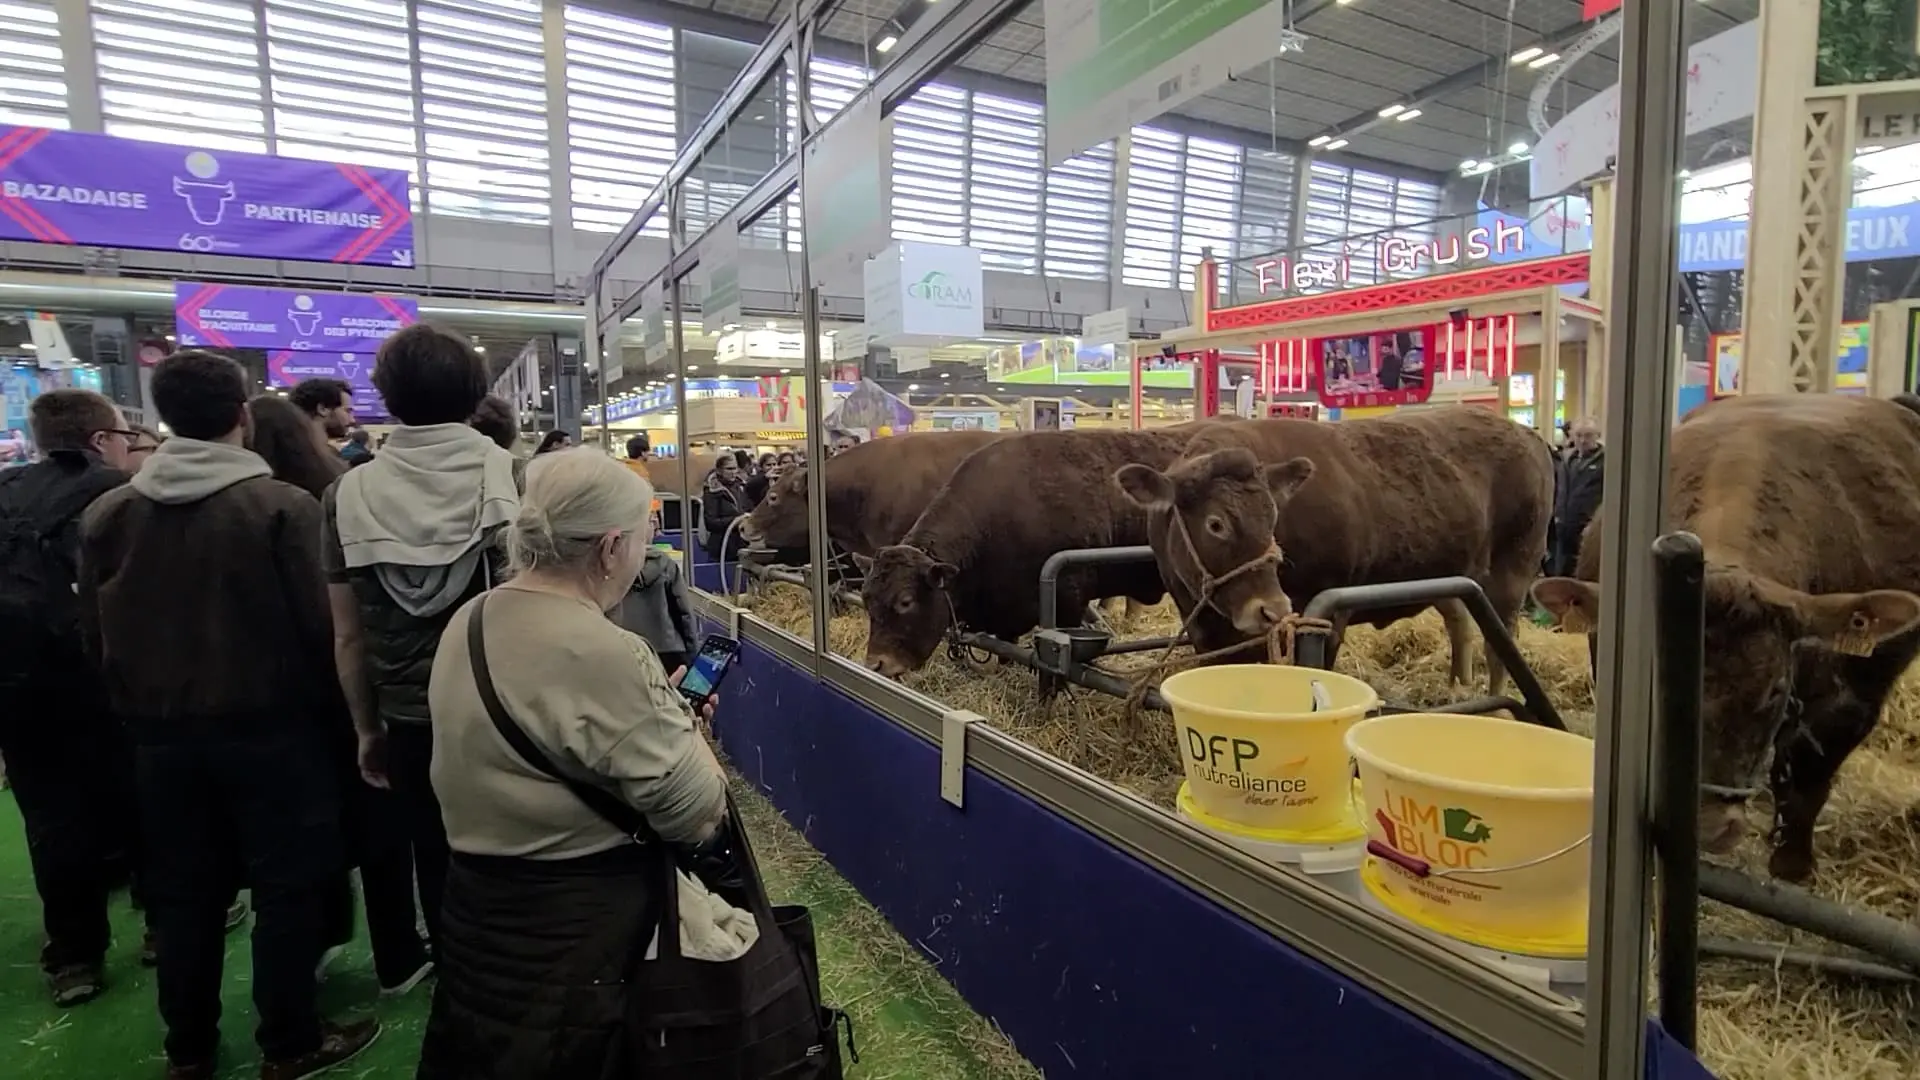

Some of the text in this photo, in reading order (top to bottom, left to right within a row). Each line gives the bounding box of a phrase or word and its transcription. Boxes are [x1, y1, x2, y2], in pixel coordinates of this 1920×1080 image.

[3, 180, 148, 209] BAZADAISE
[244, 203, 384, 230] PARTHENAISE
[1256, 245, 1350, 295] Flexi
[1381, 219, 1525, 272] Crush
[1186, 726, 1260, 773] DFP
[1193, 763, 1307, 793] nutraliance
[1384, 789, 1439, 834] LIM
[1398, 823, 1488, 870] BLOC
